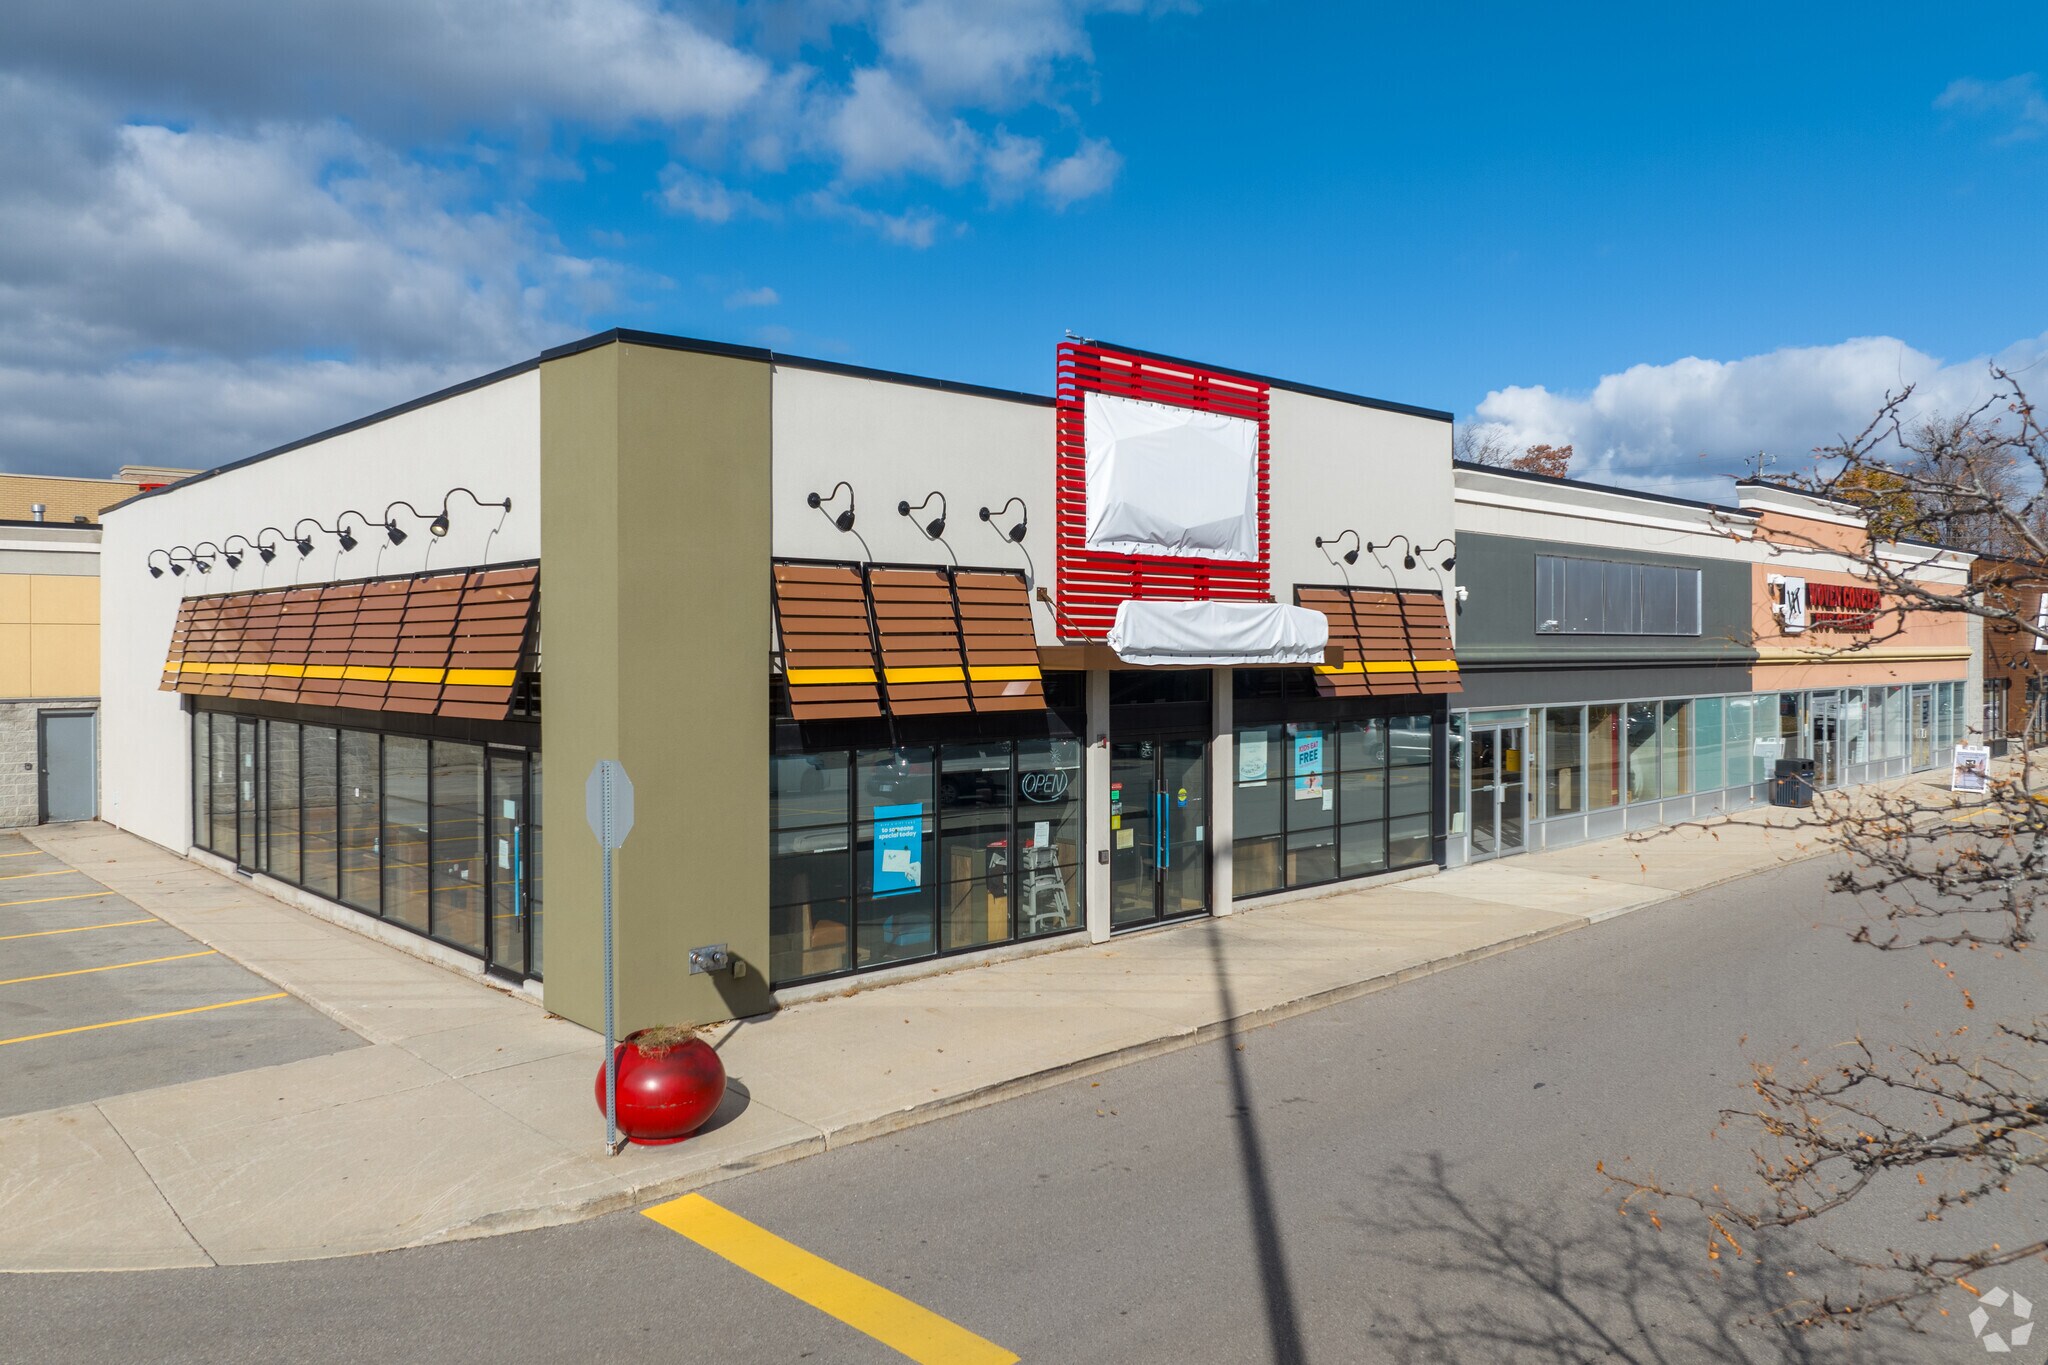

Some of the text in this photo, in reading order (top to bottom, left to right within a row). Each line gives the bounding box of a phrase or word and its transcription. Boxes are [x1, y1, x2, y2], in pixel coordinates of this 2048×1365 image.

[1808, 582, 1842, 607] WOVEN
[1299, 749, 1318, 764] FREE
[1025, 773, 1064, 793] OPEN
[878, 832, 899, 840] special
